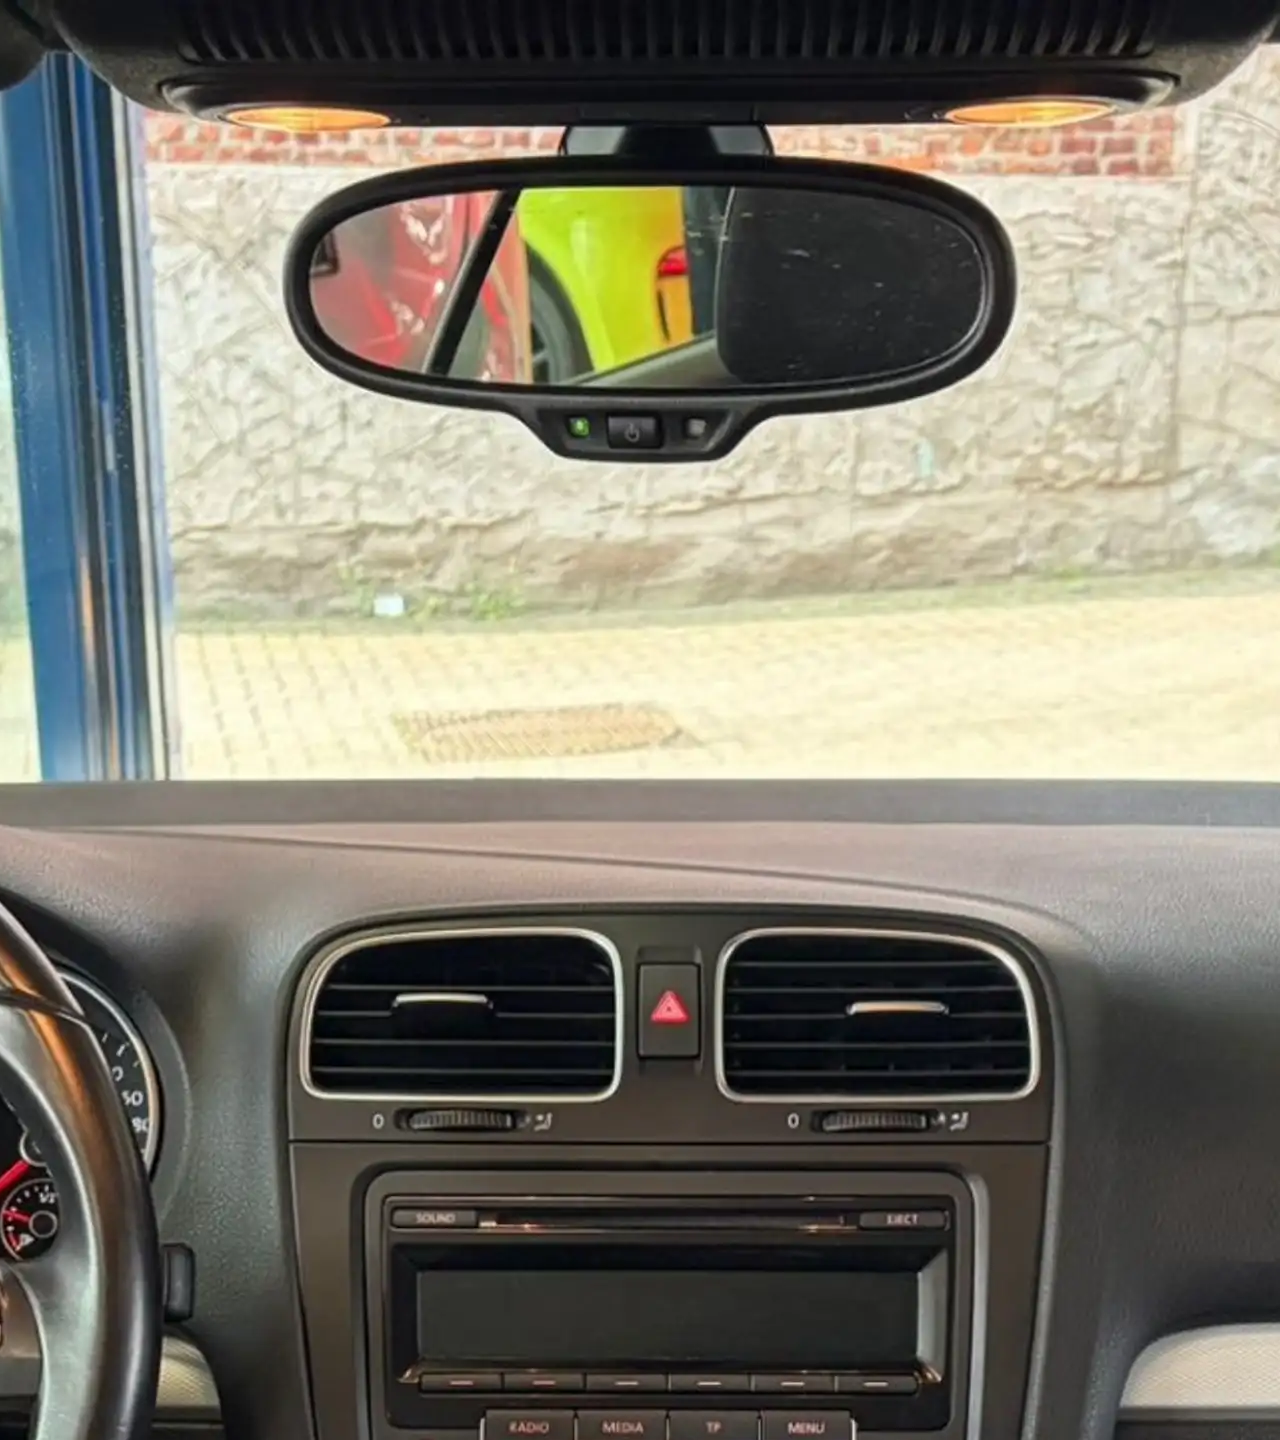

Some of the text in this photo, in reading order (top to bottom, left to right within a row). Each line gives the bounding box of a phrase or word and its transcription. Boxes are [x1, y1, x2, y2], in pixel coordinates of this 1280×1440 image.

[372, 1113, 385, 1129] 0
[787, 1112, 800, 1129] 0
[416, 1212, 456, 1224] SOUND
[886, 1213, 919, 1226] EJECT
[509, 1421, 550, 1433] RADIO
[602, 1422, 644, 1434] MEDIA
[706, 1421, 721, 1433] TP
[787, 1422, 826, 1434] MENU
